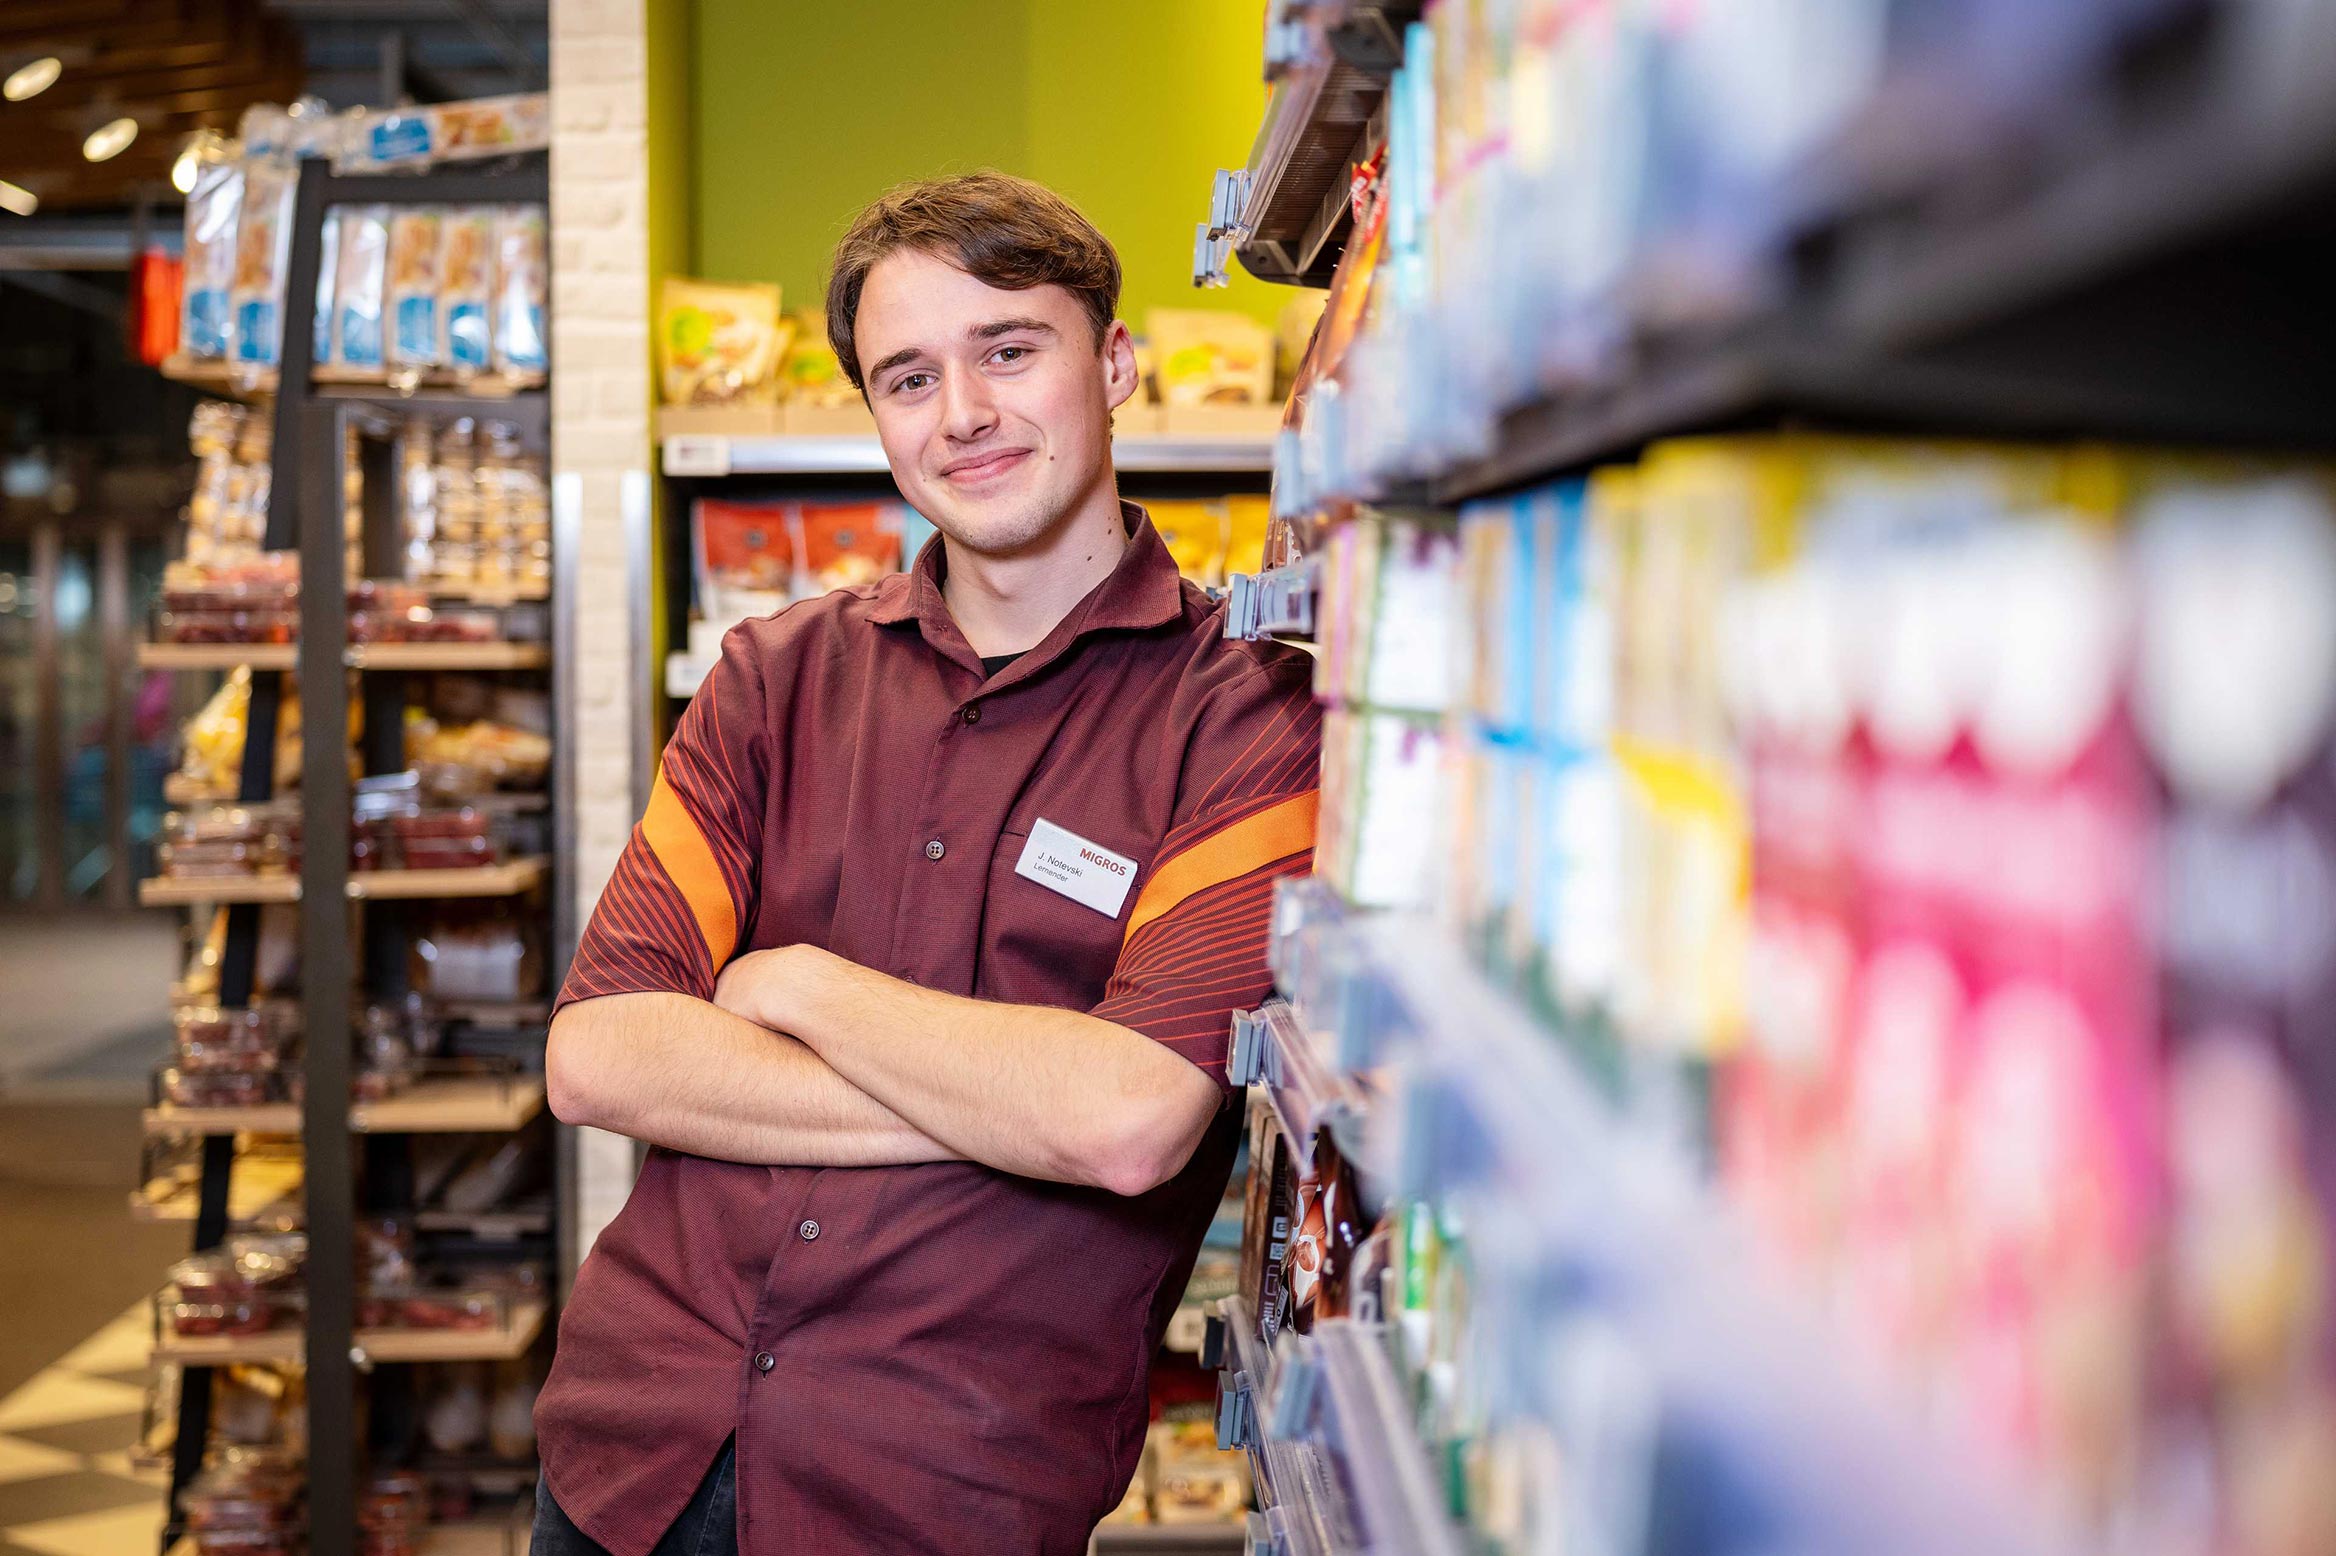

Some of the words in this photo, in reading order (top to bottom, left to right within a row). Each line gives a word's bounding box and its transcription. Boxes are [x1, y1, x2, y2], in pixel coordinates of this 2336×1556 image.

[1033, 862, 1069, 882] Lernender
[1038, 852, 1045, 861] J.
[1047, 856, 1084, 877] Notevski
[1079, 848, 1127, 876] MIGROS
